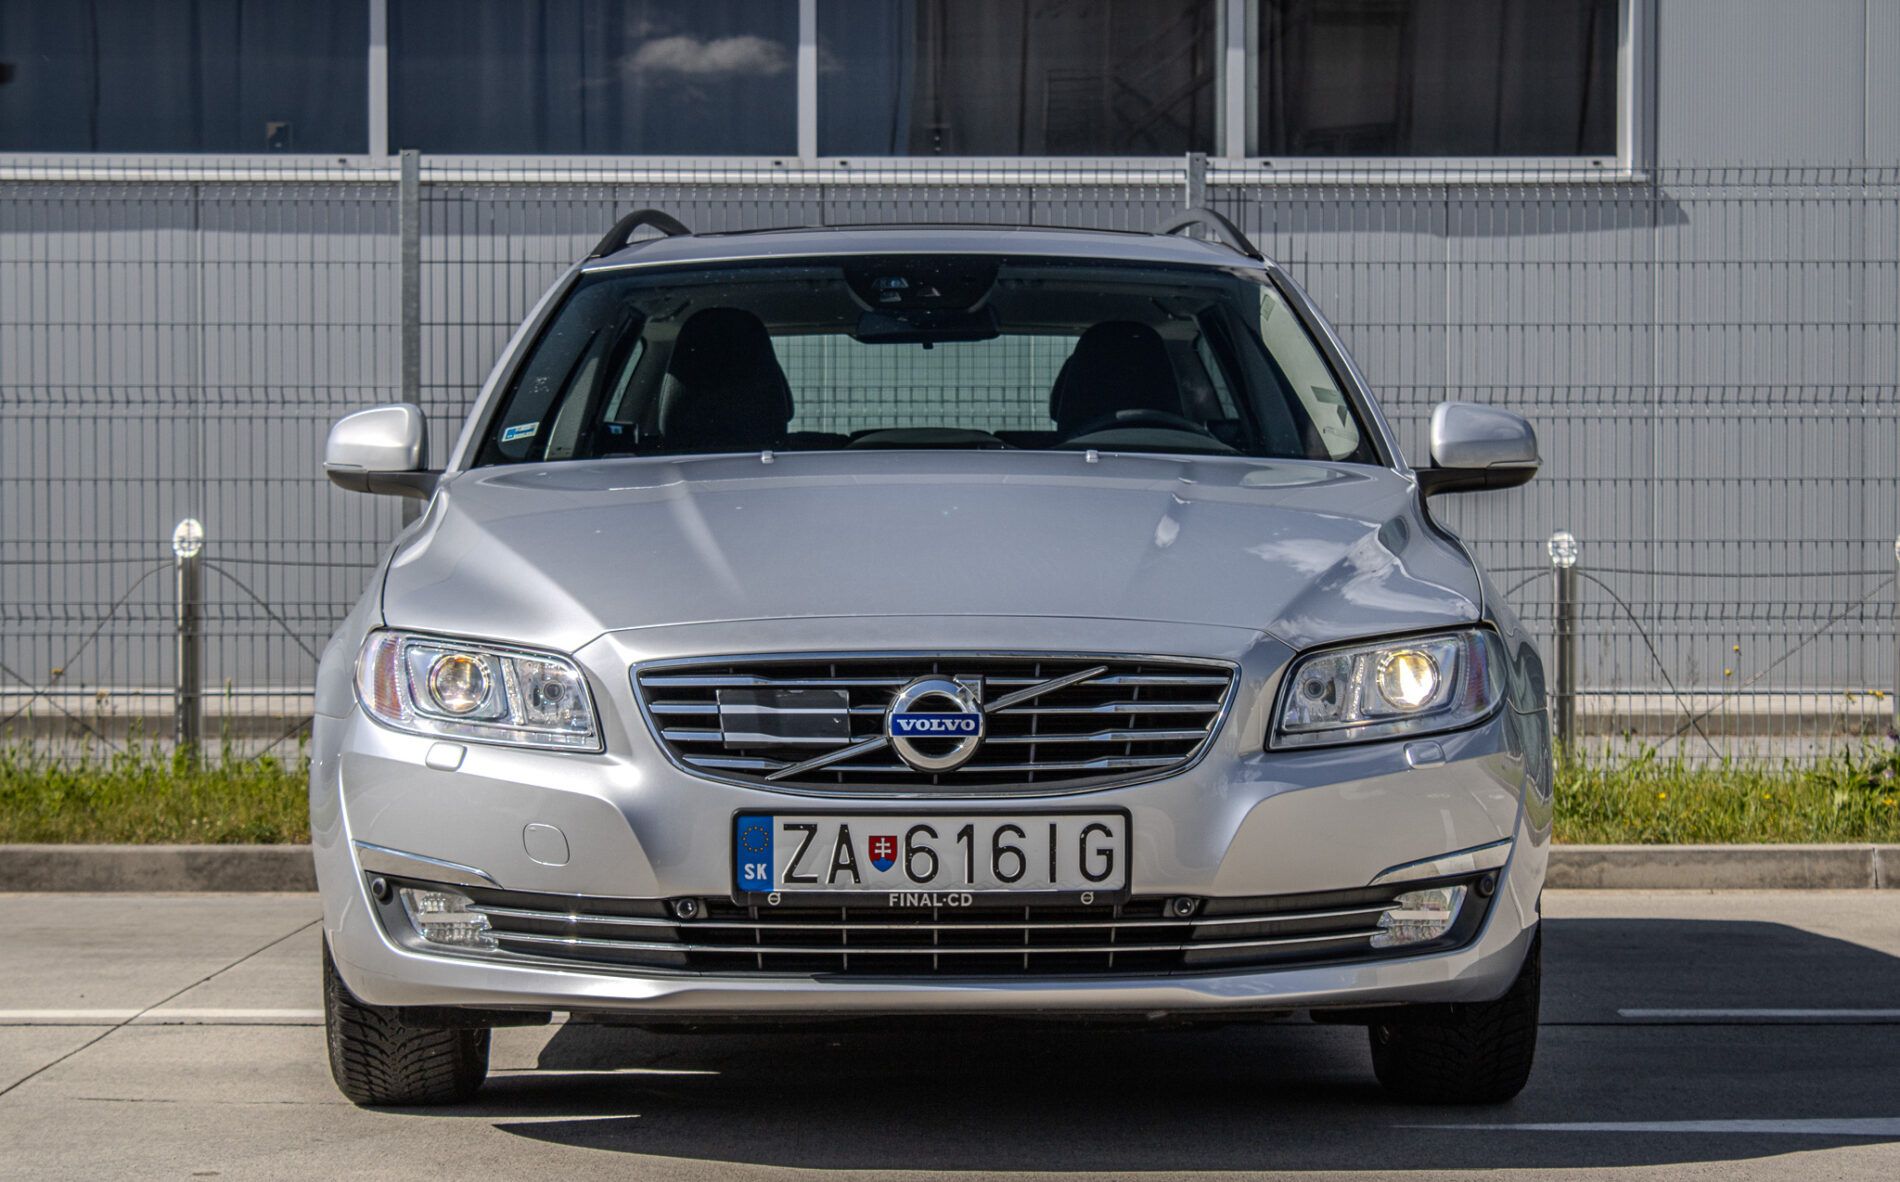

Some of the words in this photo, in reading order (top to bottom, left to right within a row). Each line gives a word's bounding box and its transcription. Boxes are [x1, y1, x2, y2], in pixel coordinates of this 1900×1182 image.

[896, 719, 976, 731] VOLVO
[782, 823, 861, 884] ZA
[903, 823, 1114, 884] 616IG
[744, 864, 768, 880] SK
